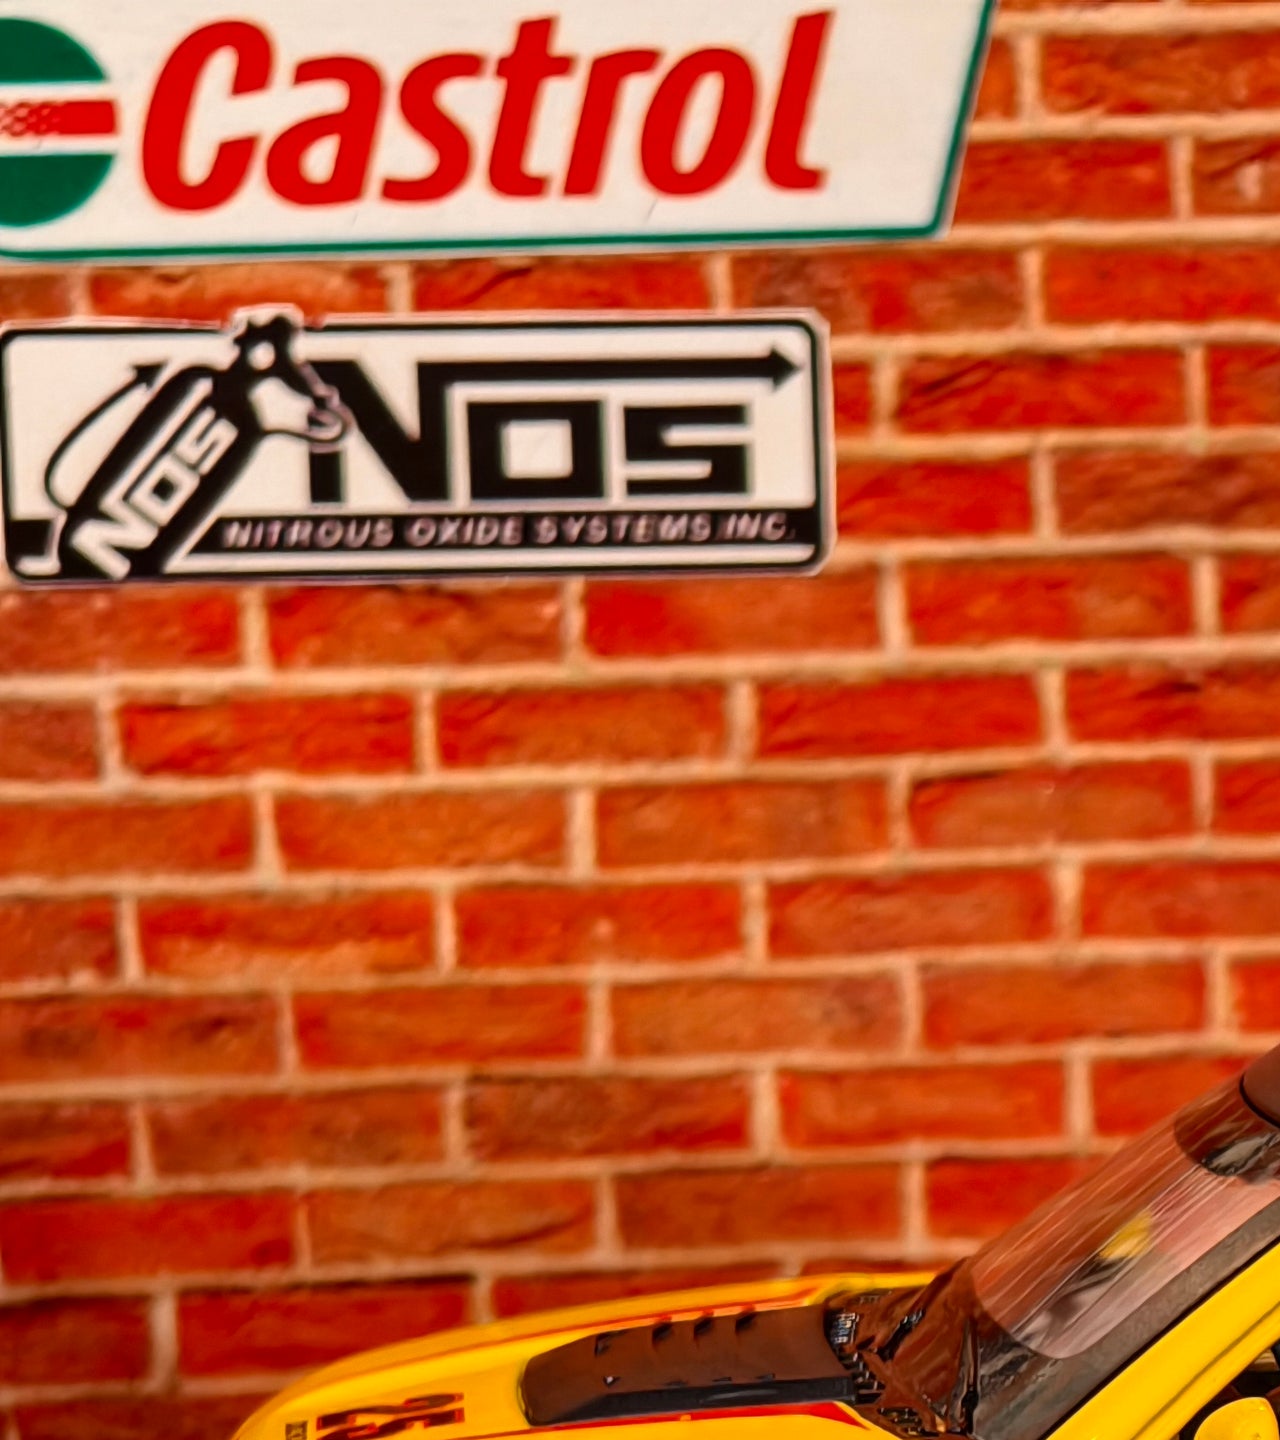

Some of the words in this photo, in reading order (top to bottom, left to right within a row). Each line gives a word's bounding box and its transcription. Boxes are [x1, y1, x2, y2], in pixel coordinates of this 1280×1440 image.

[140, 8, 834, 213] Castrol
[70, 400, 239, 581] NOS
[307, 359, 752, 502] NOS
[222, 518, 394, 549] NITROUS
[404, 515, 525, 547] OXIDE
[534, 511, 712, 545] SYSTEMS
